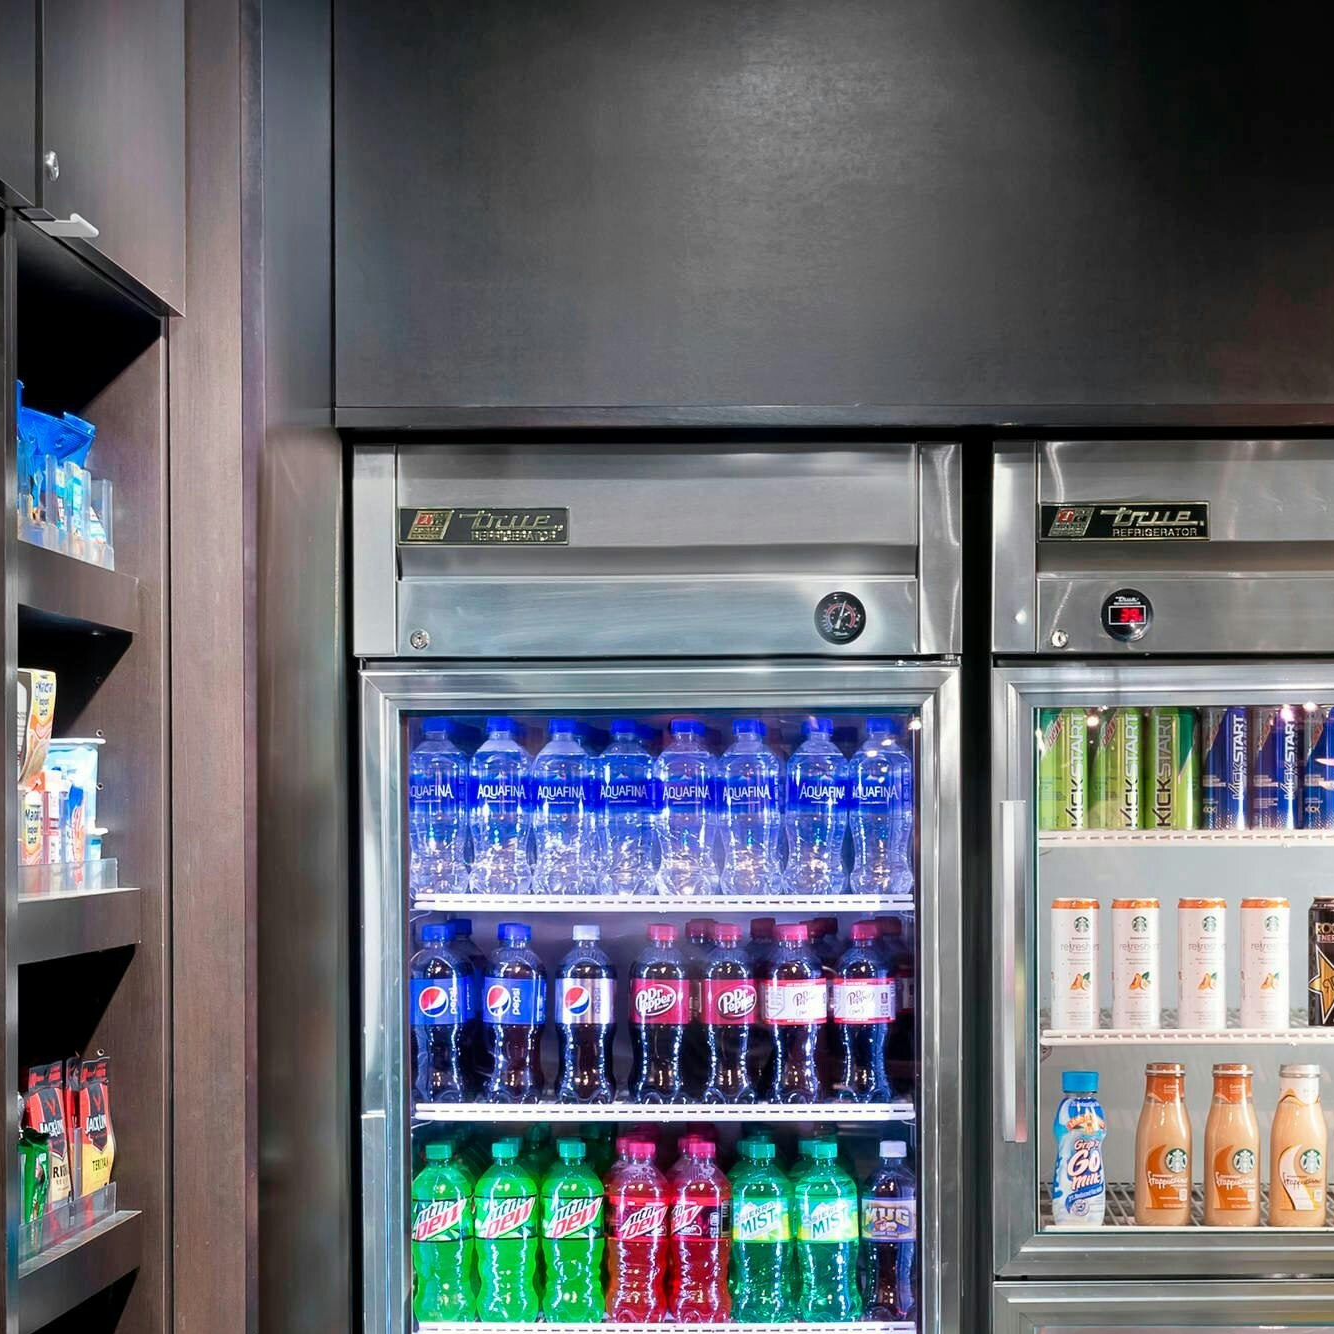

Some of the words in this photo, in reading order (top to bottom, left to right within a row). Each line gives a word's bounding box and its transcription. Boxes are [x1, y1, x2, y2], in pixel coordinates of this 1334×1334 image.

[1112, 527, 1198, 537] REFRIGERATOR
[1228, 714, 1245, 800] KICKSTART
[1152, 714, 1171, 828] KICKSTART
[410, 784, 454, 800] QUAFINA
[477, 783, 527, 800] AQUAFINA
[537, 784, 585, 801] AQUAFINA
[600, 784, 648, 800] AQUAFINA
[662, 784, 711, 801] AQUAFINA
[722, 783, 772, 801] AQUAFINA
[512, 987, 522, 1016] pepsi
[635, 990, 676, 1015] Pepper
[740, 1209, 777, 1235] MIST
[865, 1207, 910, 1224] MUG
